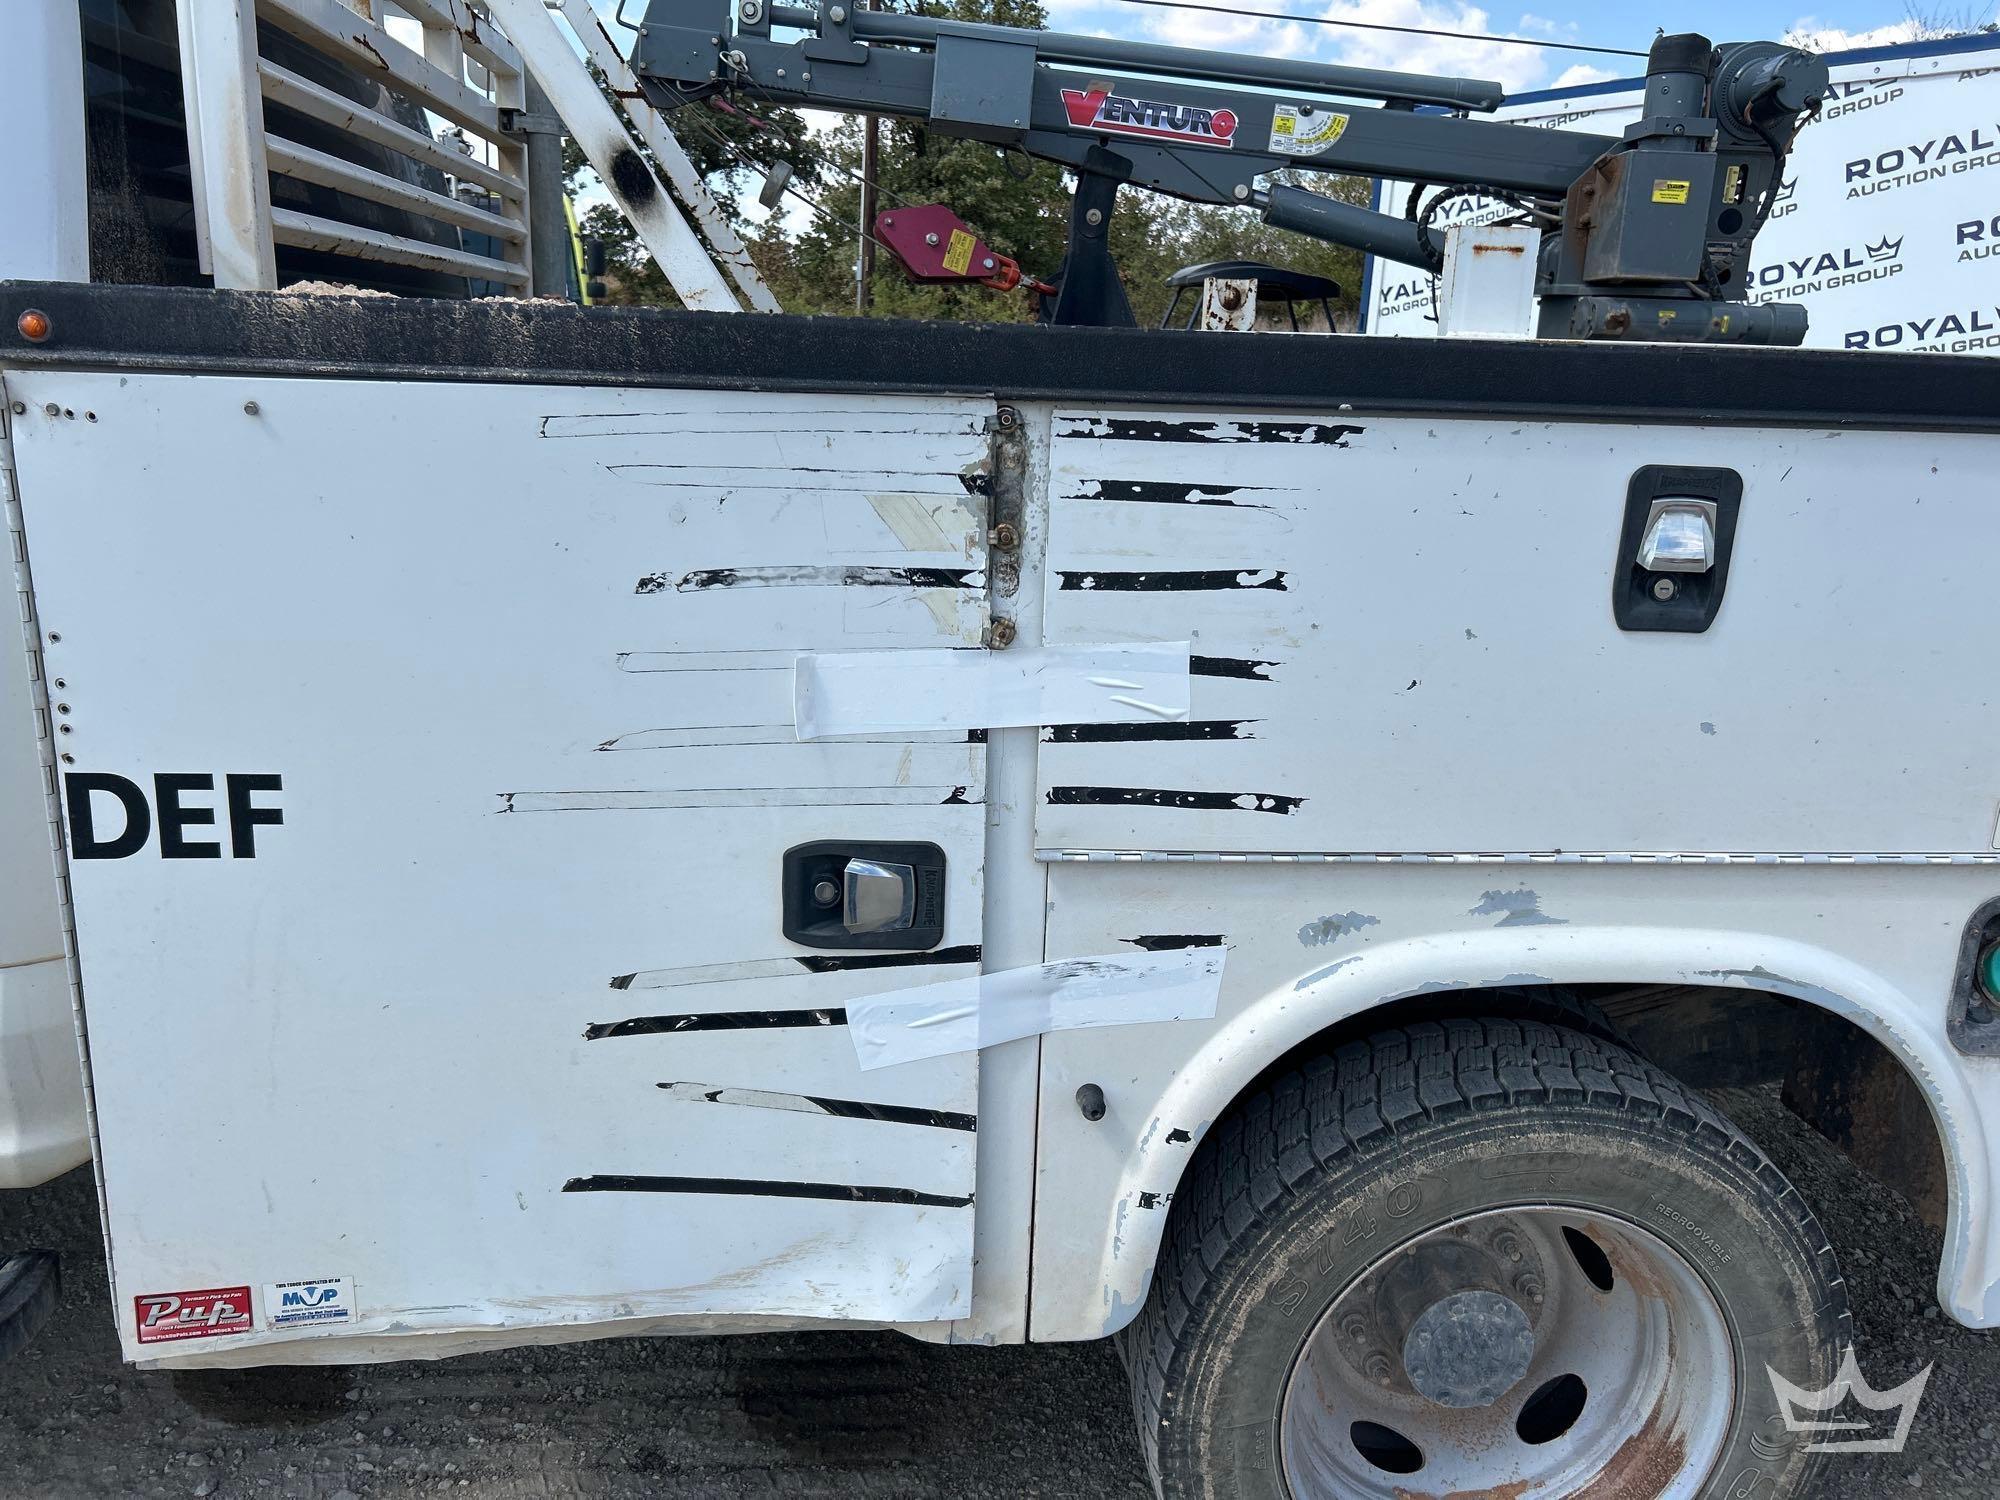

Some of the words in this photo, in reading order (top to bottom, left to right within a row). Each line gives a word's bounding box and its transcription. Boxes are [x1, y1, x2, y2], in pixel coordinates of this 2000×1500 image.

[1061, 89, 1238, 139] VENTURO
[1827, 87, 1904, 120] GROUP
[1845, 129, 1994, 183] ROYAL
[1846, 165, 1946, 200] AUCTION
[1952, 152, 2000, 174] GRO
[1429, 194, 1490, 224] YAL
[1380, 281, 1424, 303] YAL
[1403, 295, 1441, 311] GROU
[1746, 280, 1822, 305] UCTION
[1827, 263, 1903, 289] GROUP
[1844, 310, 1994, 350] ROYAL
[1951, 335, 2000, 353] GRO
[64, 772, 285, 860] DEF
[1655, 1203, 1732, 1264] REGROOVABLE
[1684, 1235, 1721, 1273] TUBELESS
[140, 1296, 244, 1327] Pup
[282, 1286, 338, 1307] MVP
